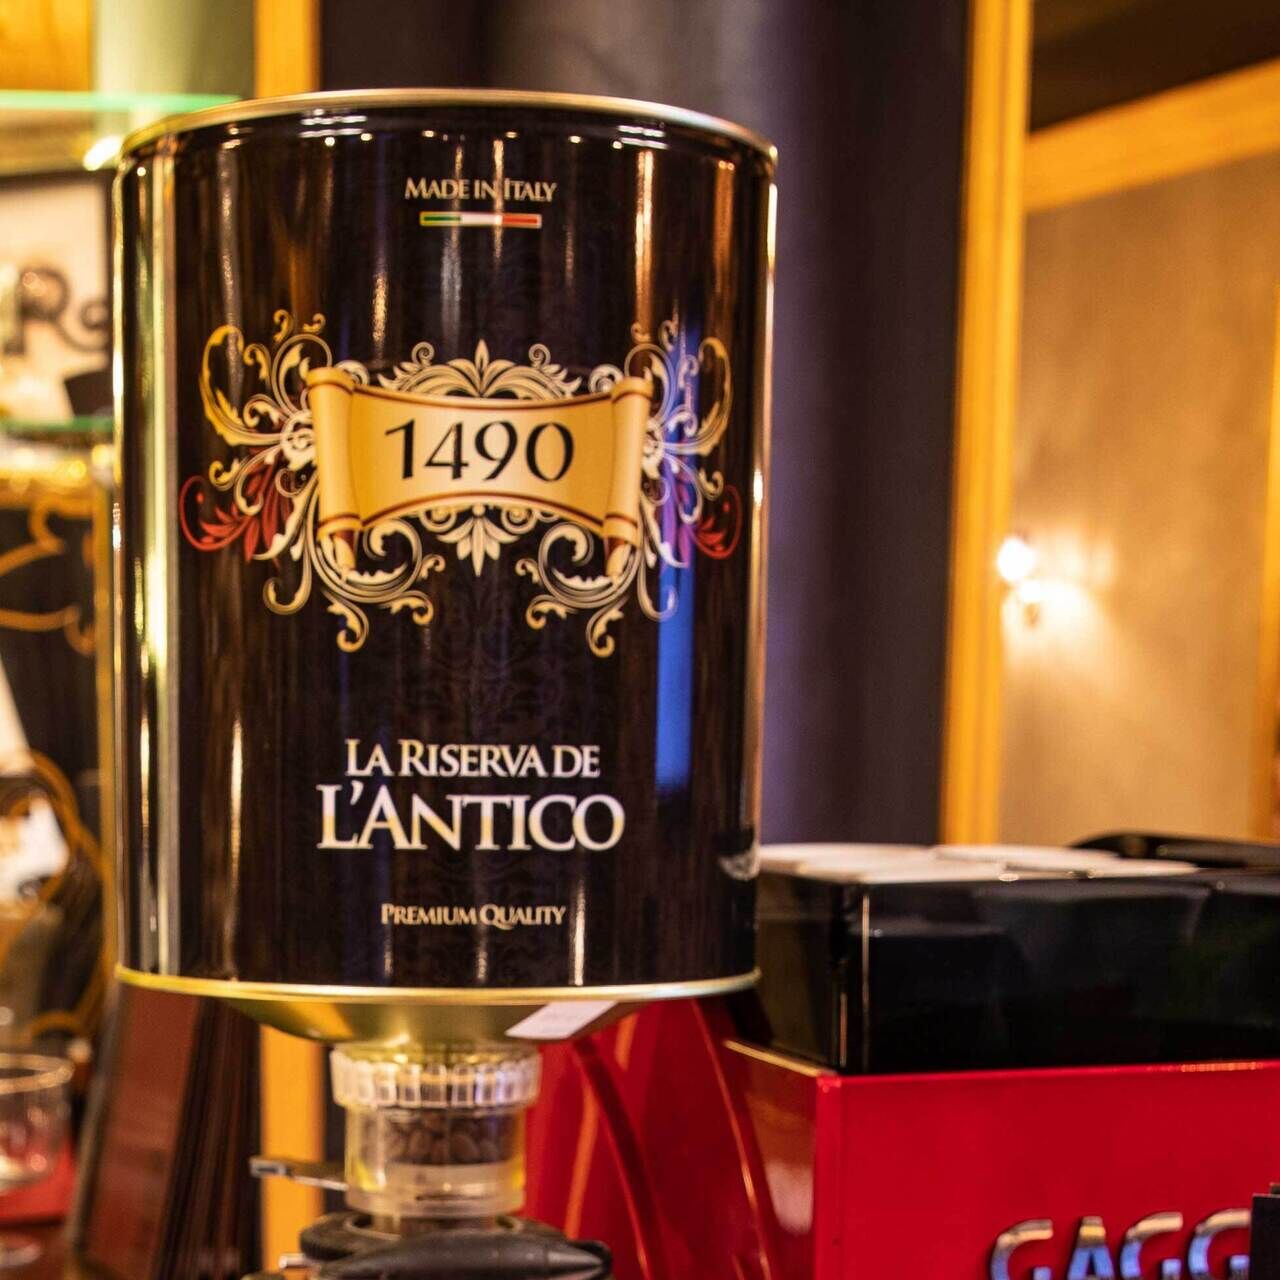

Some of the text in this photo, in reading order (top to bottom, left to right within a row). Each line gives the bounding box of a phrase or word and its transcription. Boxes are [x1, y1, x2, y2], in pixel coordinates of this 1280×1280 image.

[405, 178, 557, 202] MADE IN ITALY
[385, 420, 575, 483] 1490
[345, 739, 600, 779] LA RISERVA DE
[316, 780, 625, 852] L'ANTICO
[380, 902, 566, 930] PREMIUM QUALITY
